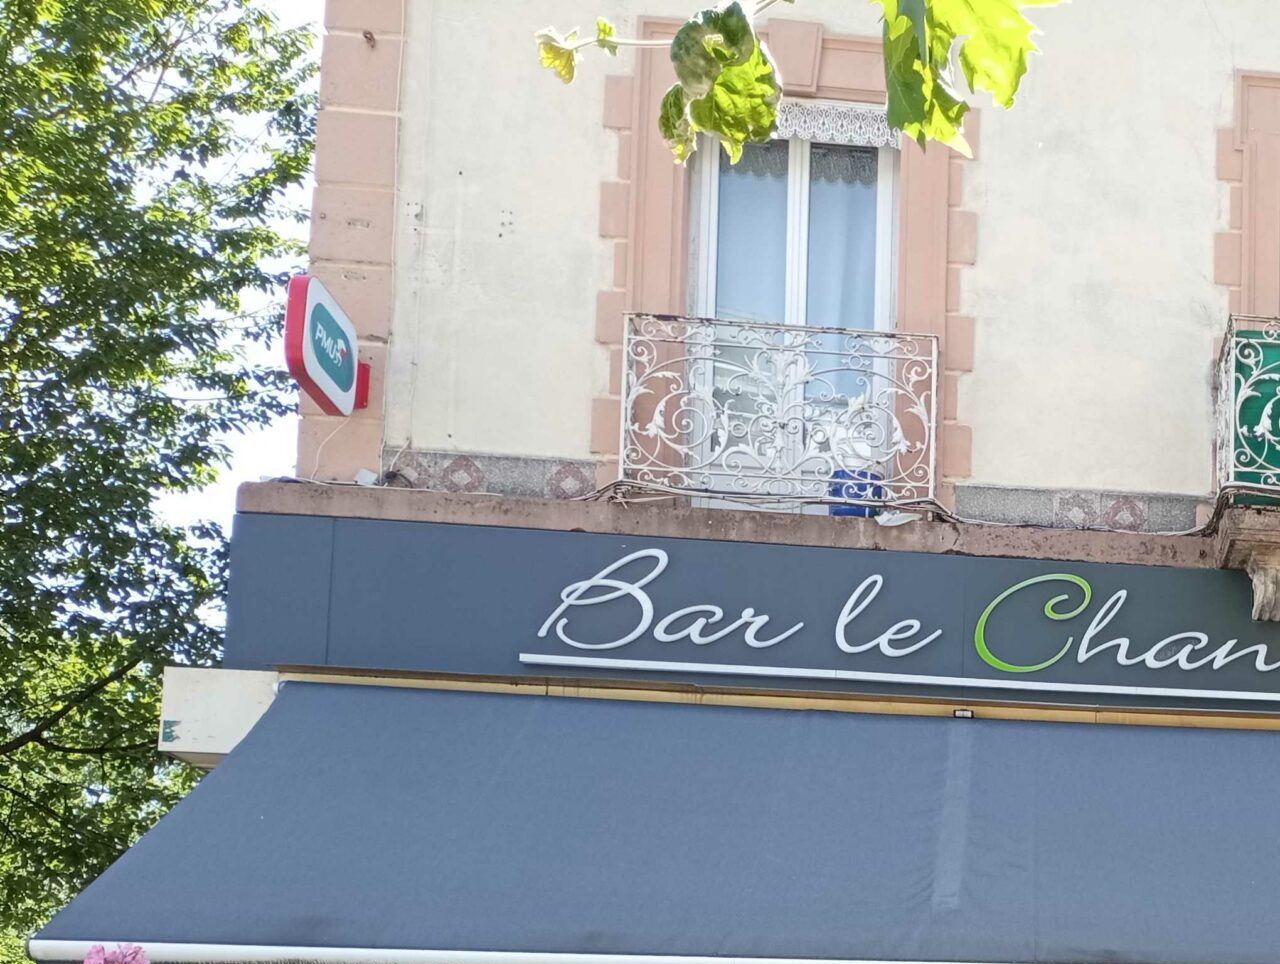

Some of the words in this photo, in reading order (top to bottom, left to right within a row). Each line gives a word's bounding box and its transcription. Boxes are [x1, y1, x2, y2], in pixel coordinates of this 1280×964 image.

[315, 321, 336, 360] PMU
[537, 547, 804, 650] Bar
[835, 573, 942, 658] le
